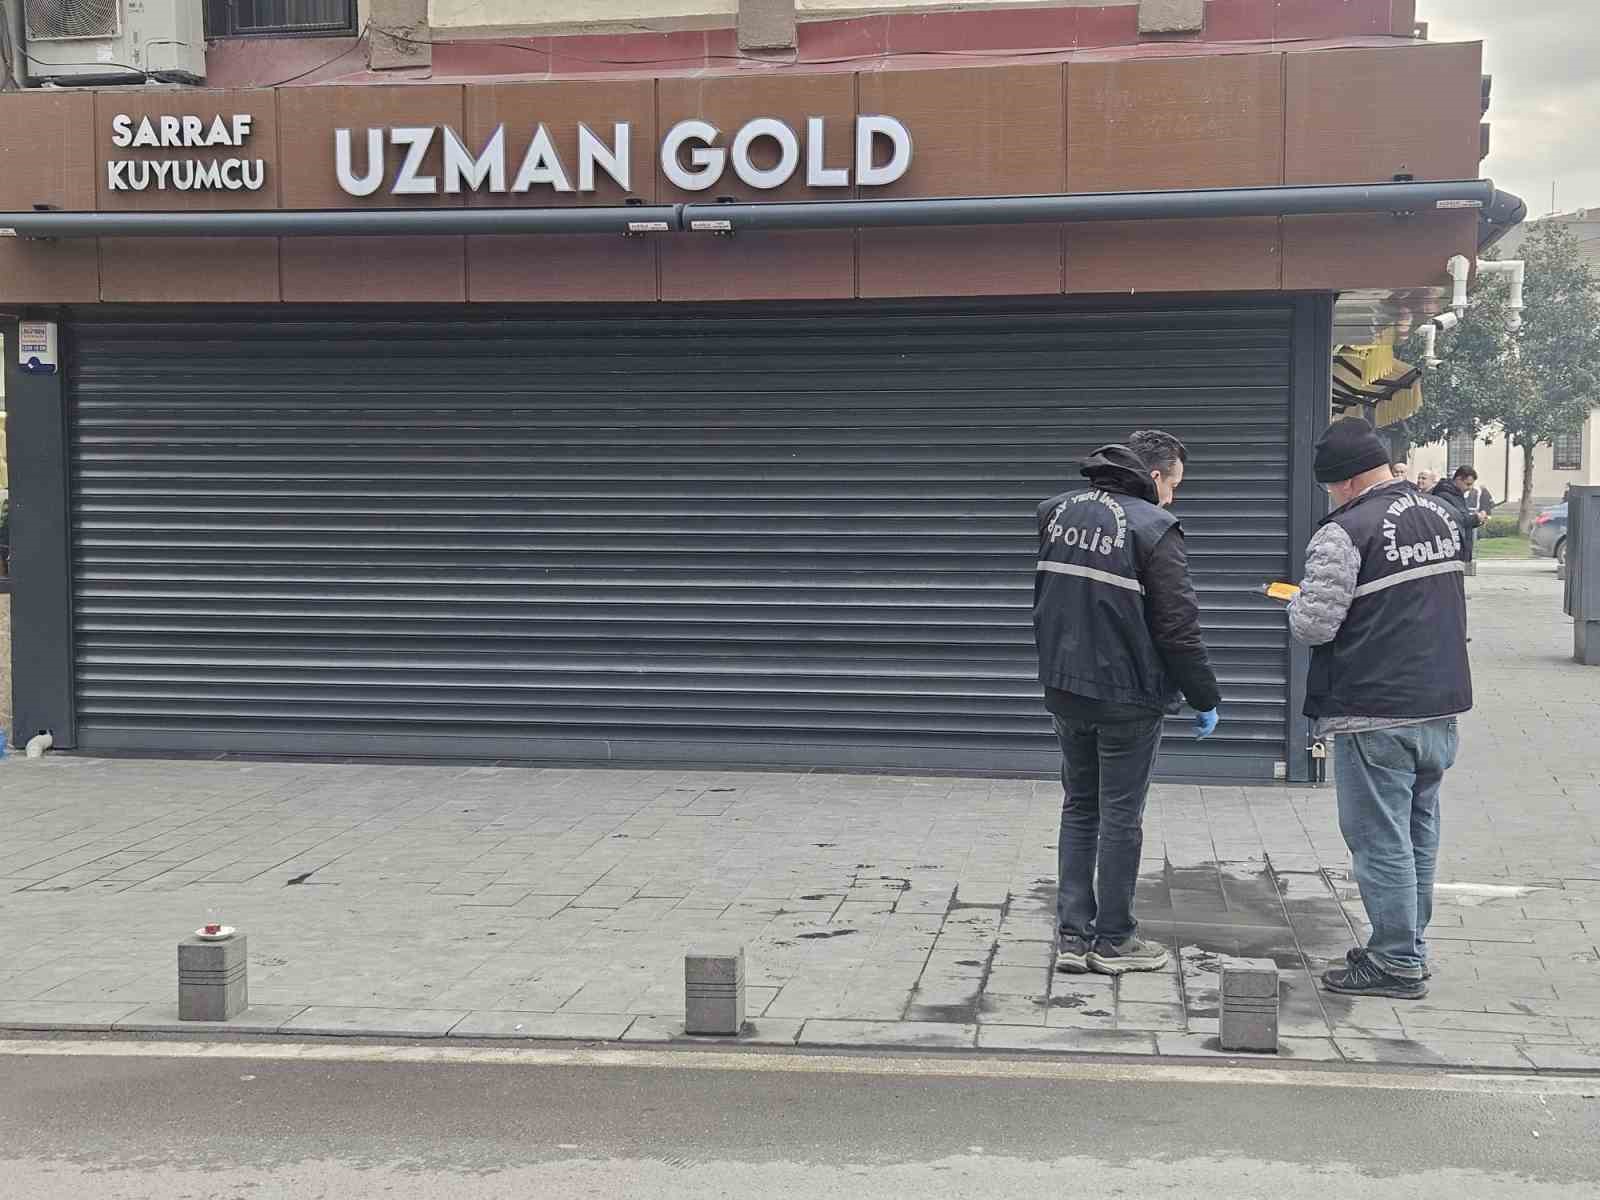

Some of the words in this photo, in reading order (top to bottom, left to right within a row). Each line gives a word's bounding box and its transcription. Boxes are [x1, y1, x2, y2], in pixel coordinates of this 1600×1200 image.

[111, 114, 251, 147] SARRAF
[335, 121, 632, 196] UZMAN
[660, 115, 914, 192] GOLD
[107, 158, 264, 190] KUYUMCU
[1049, 525, 1113, 555] POLİS
[1383, 518, 1400, 561] OLAY
[1399, 535, 1455, 567] POLİS
